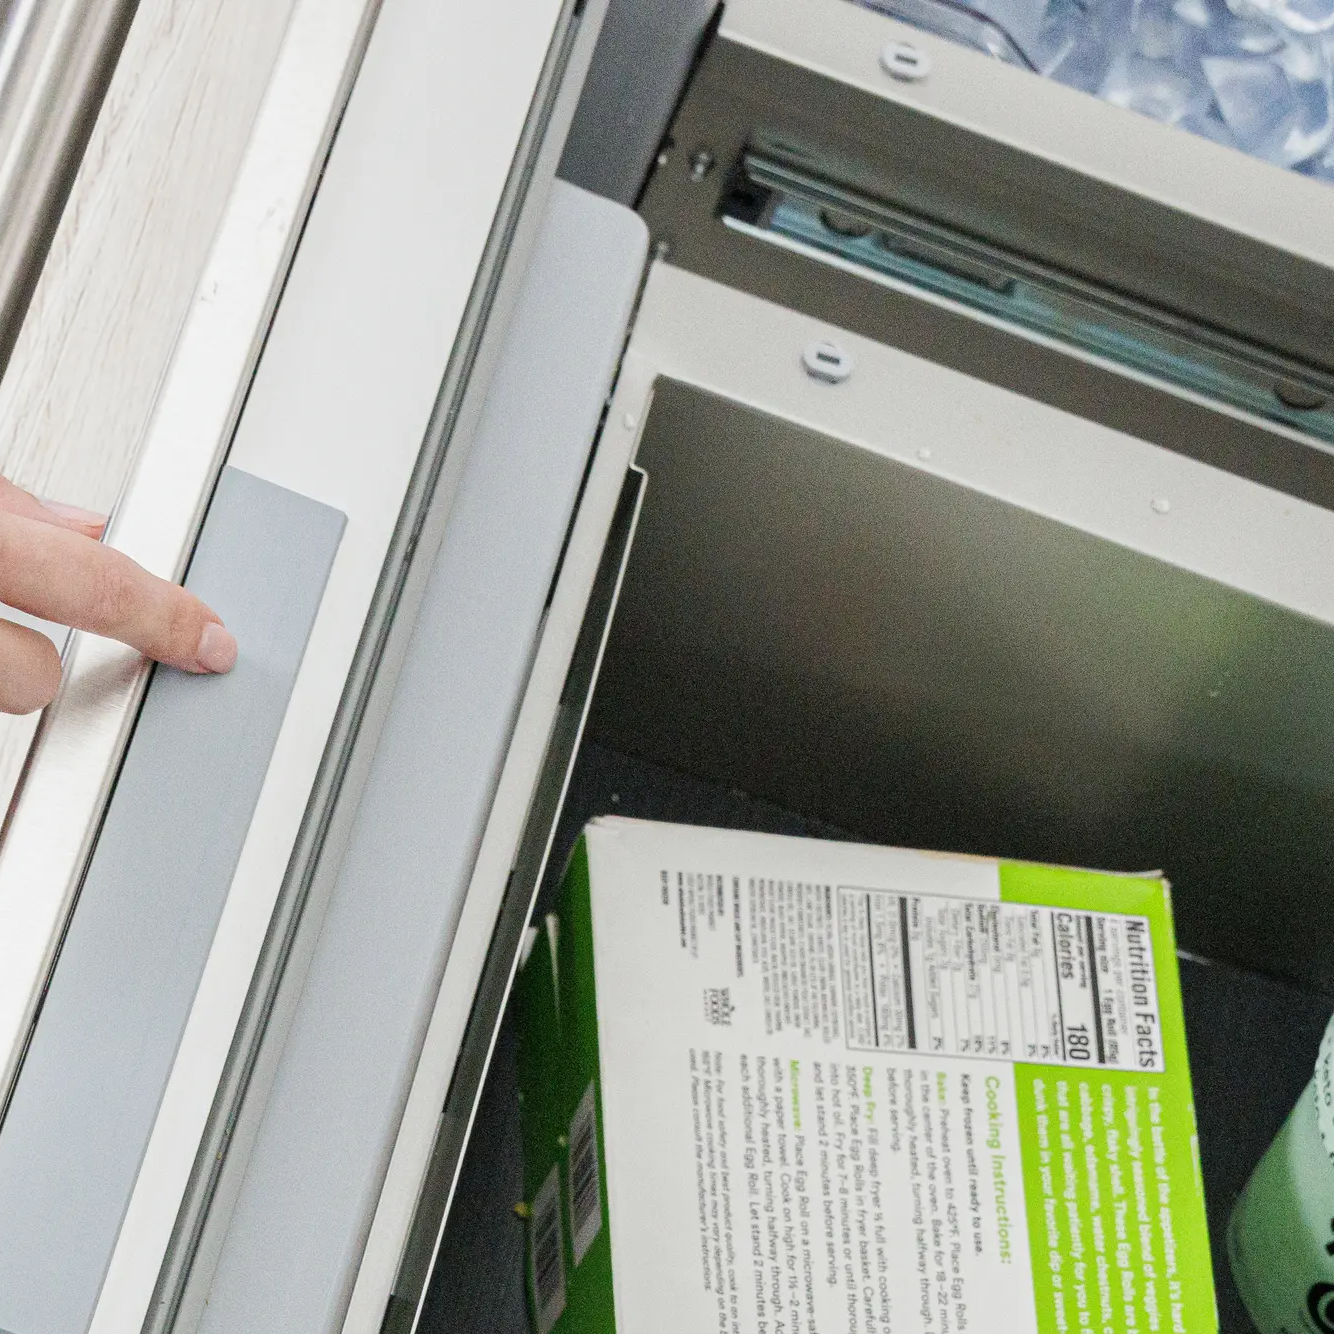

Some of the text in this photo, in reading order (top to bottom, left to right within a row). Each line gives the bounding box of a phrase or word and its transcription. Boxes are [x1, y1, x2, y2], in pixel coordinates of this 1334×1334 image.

[1055, 911, 1077, 980] Calories
[1124, 919, 1158, 1068] Nutrition Facts
[1066, 1023, 1092, 1061] 180
[885, 1066, 899, 1106] before
[919, 1069, 929, 1082] in
[902, 1067, 917, 1133] thoroughly
[919, 1083, 931, 1104] the
[921, 1105, 934, 1144] center
[939, 1107, 952, 1154] Preheat
[742, 1146, 758, 1170] Egg
[924, 1145, 938, 1160] of
[959, 1072, 984, 1256] Keep frozen until ready to use.
[926, 1160, 938, 1182] the
[941, 1155, 953, 1185] oven
[983, 1074, 1012, 1266] Cooking Instructions:
[911, 1181, 924, 1226] turning
[945, 1186, 955, 1200] to
[748, 1200, 761, 1221] Let
[749, 1223, 764, 1257] stand
[930, 1217, 944, 1248] Bake
[752, 1258, 765, 1268] 2
[915, 1227, 929, 1275] halfway
[932, 1249, 946, 1267] for
[949, 1241, 962, 1275] Place
[1115, 1240, 1132, 1270] Egg
[754, 1268, 767, 1318] minutes
[919, 1276, 934, 1327] through.
[950, 1276, 965, 1300] Egg
[954, 1302, 968, 1331] Rolls
